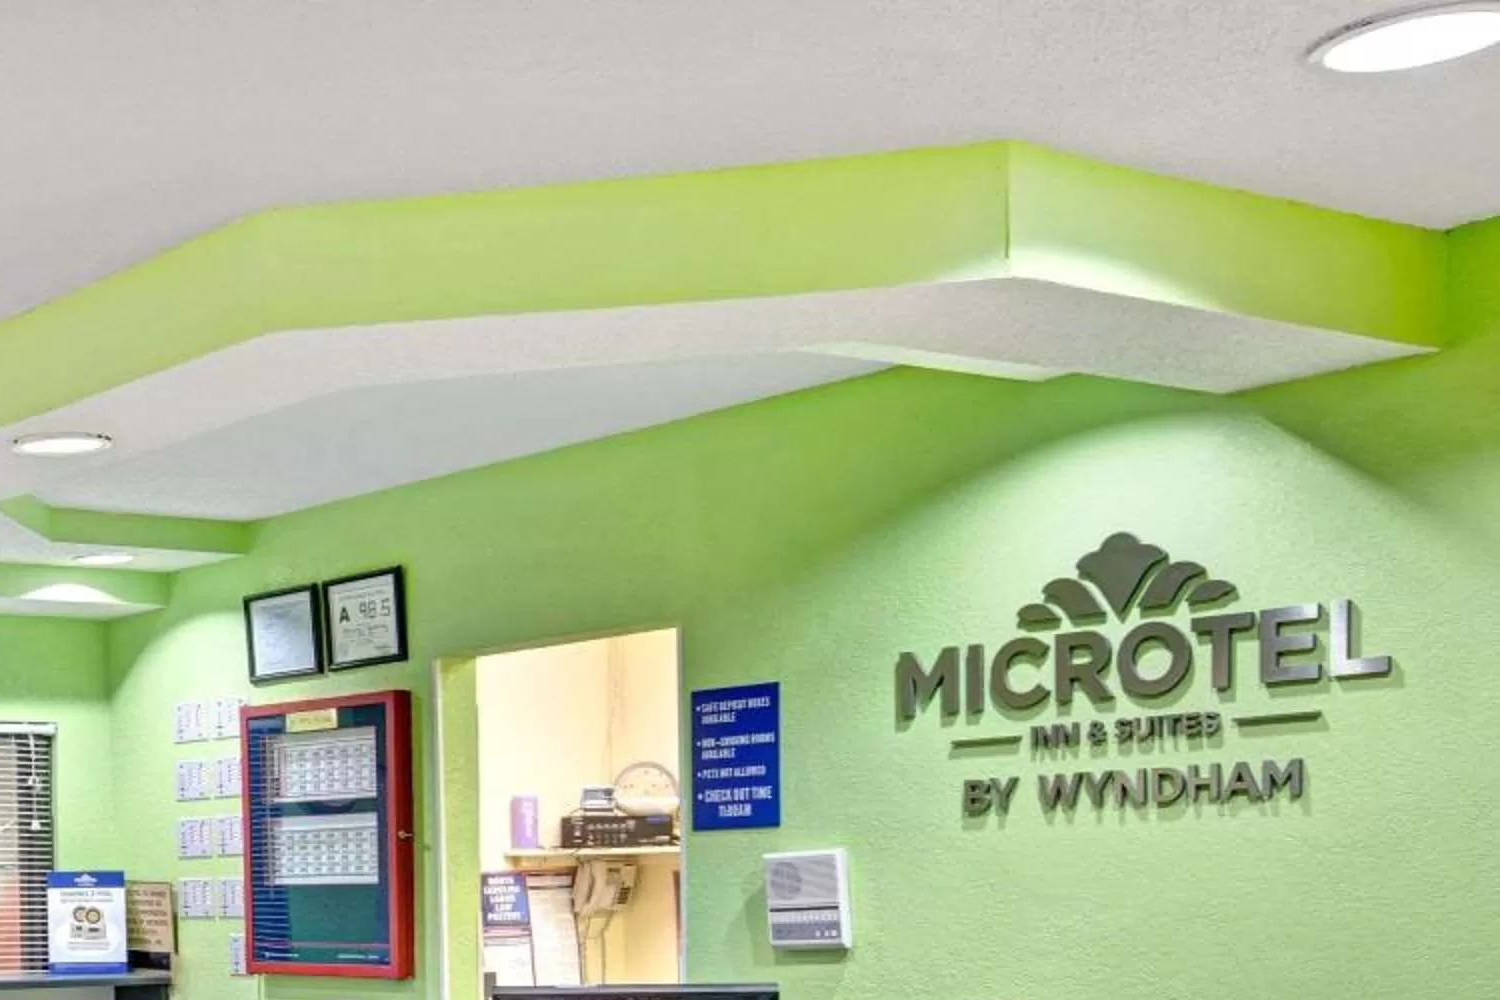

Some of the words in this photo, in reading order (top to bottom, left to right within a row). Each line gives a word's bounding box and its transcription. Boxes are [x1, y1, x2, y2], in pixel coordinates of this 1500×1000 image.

[339, 606, 351, 624] A
[896, 599, 1393, 722] MICROTEL
[1031, 723, 1081, 753] INN
[1087, 720, 1108, 746] &
[1114, 711, 1222, 744] SUITES
[705, 789, 732, 803] CHECK
[733, 787, 749, 801] OUT
[751, 785, 773, 799] TIME
[962, 776, 1020, 818] BY
[1039, 757, 1305, 812] WYNDHAM
